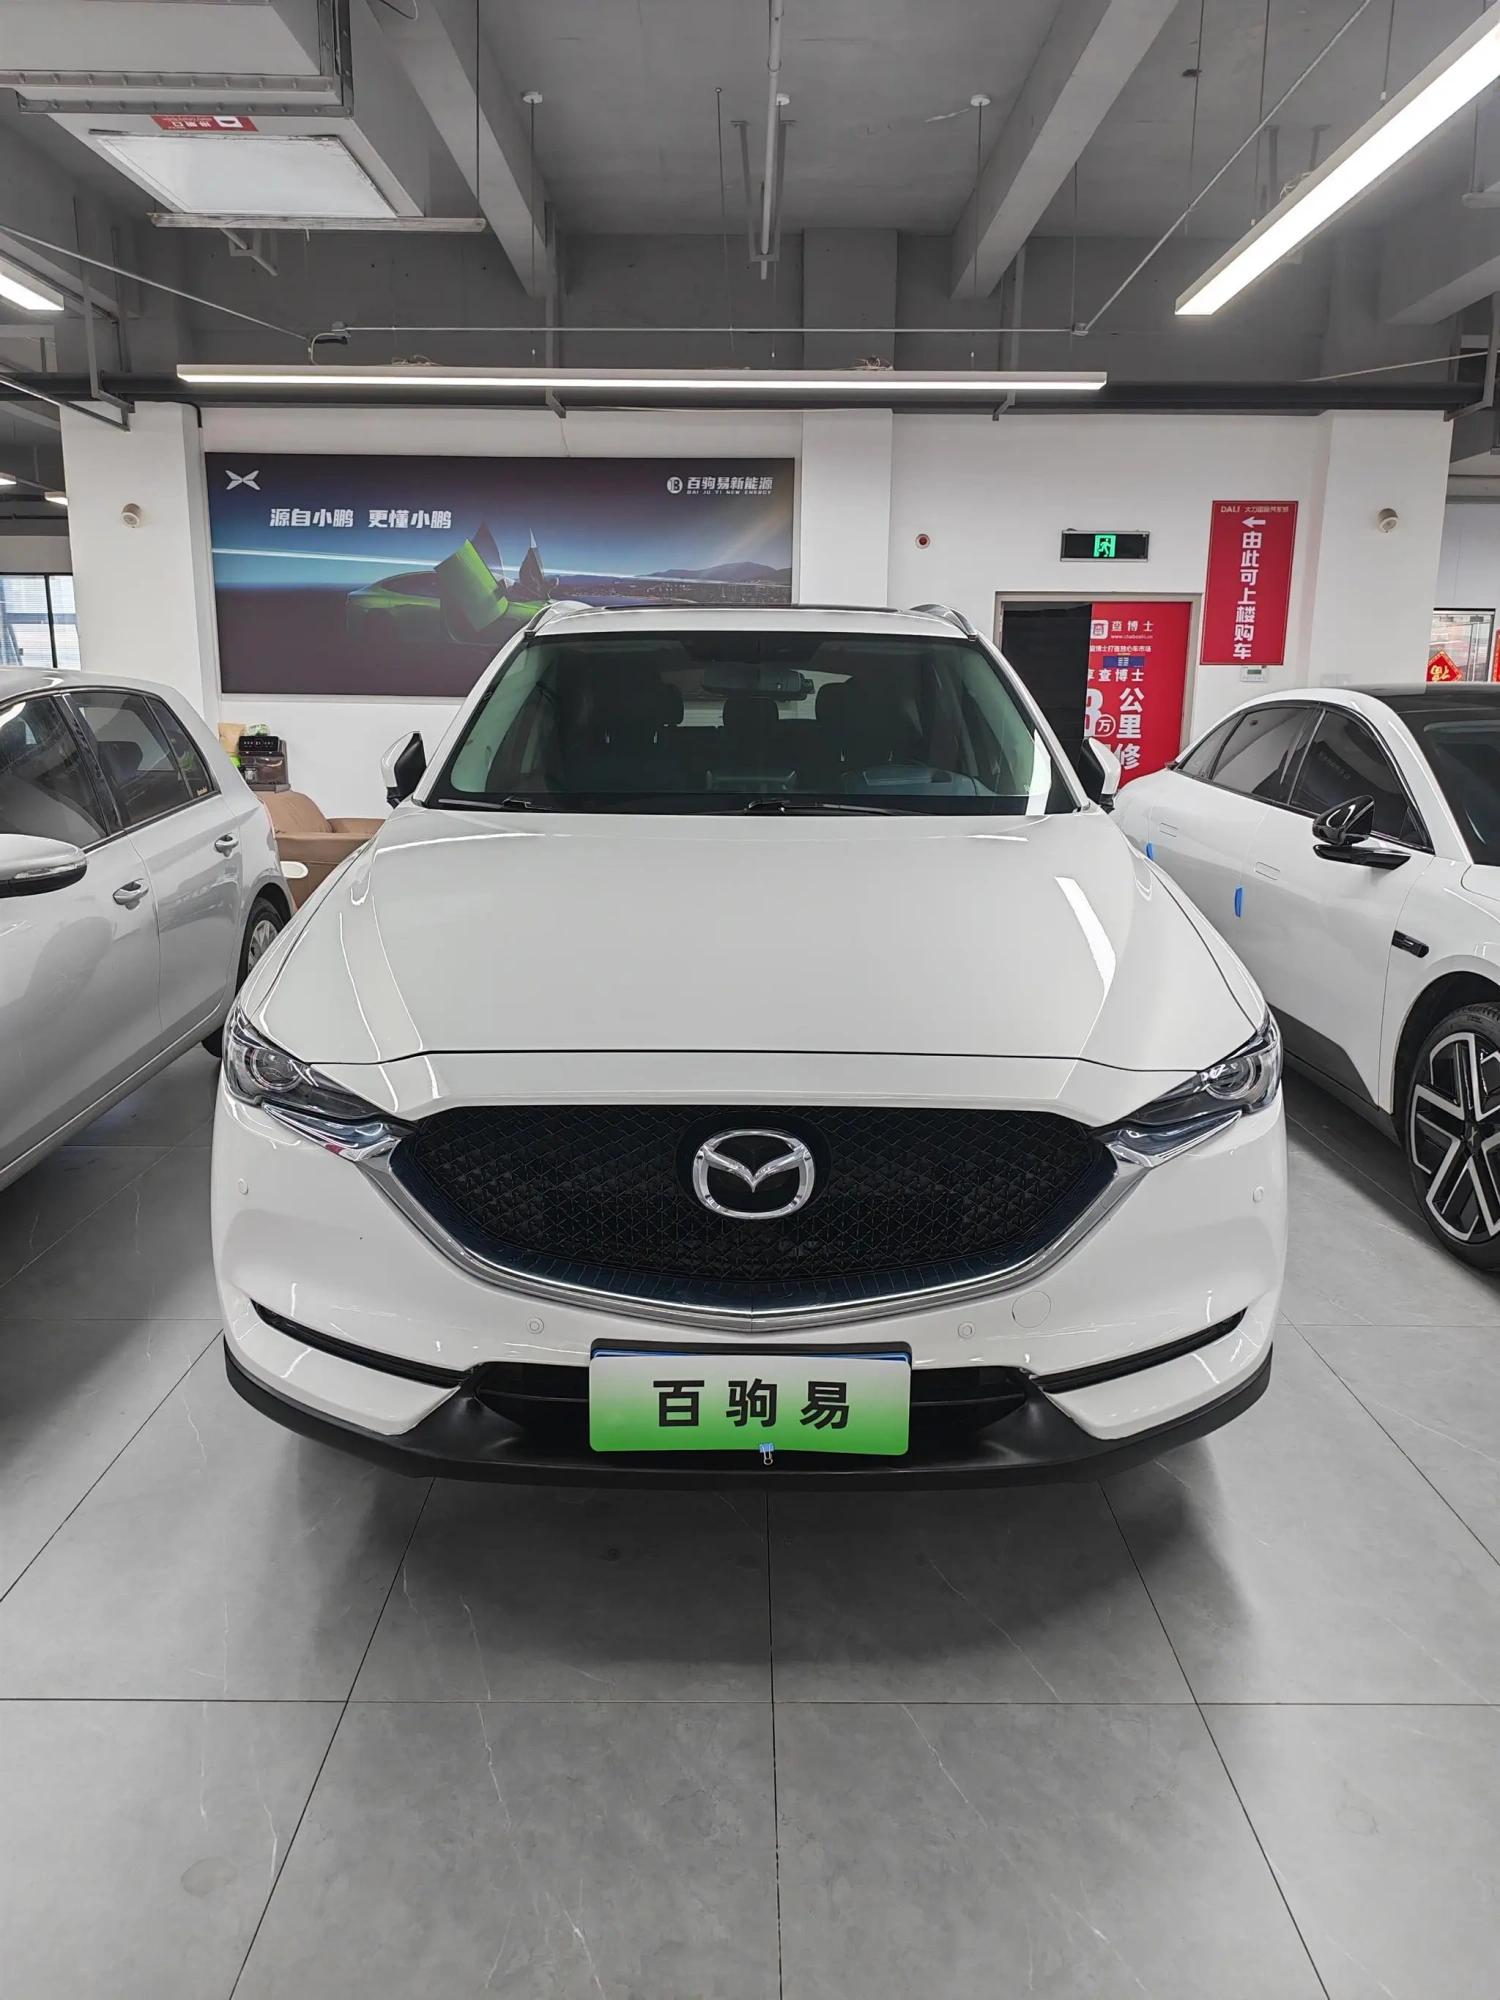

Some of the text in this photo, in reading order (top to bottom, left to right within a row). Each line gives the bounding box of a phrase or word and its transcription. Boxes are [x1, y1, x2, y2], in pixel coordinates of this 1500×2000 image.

[687, 476, 773, 490] 百驹易新能源
[1220, 505, 1240, 513] DALI
[269, 508, 452, 529] 源自小鹏 更懂小鹏
[1233, 531, 1262, 660] 由此可上楼购车
[1111, 620, 1154, 632] 查博士
[652, 1378, 850, 1430] 百驹易
